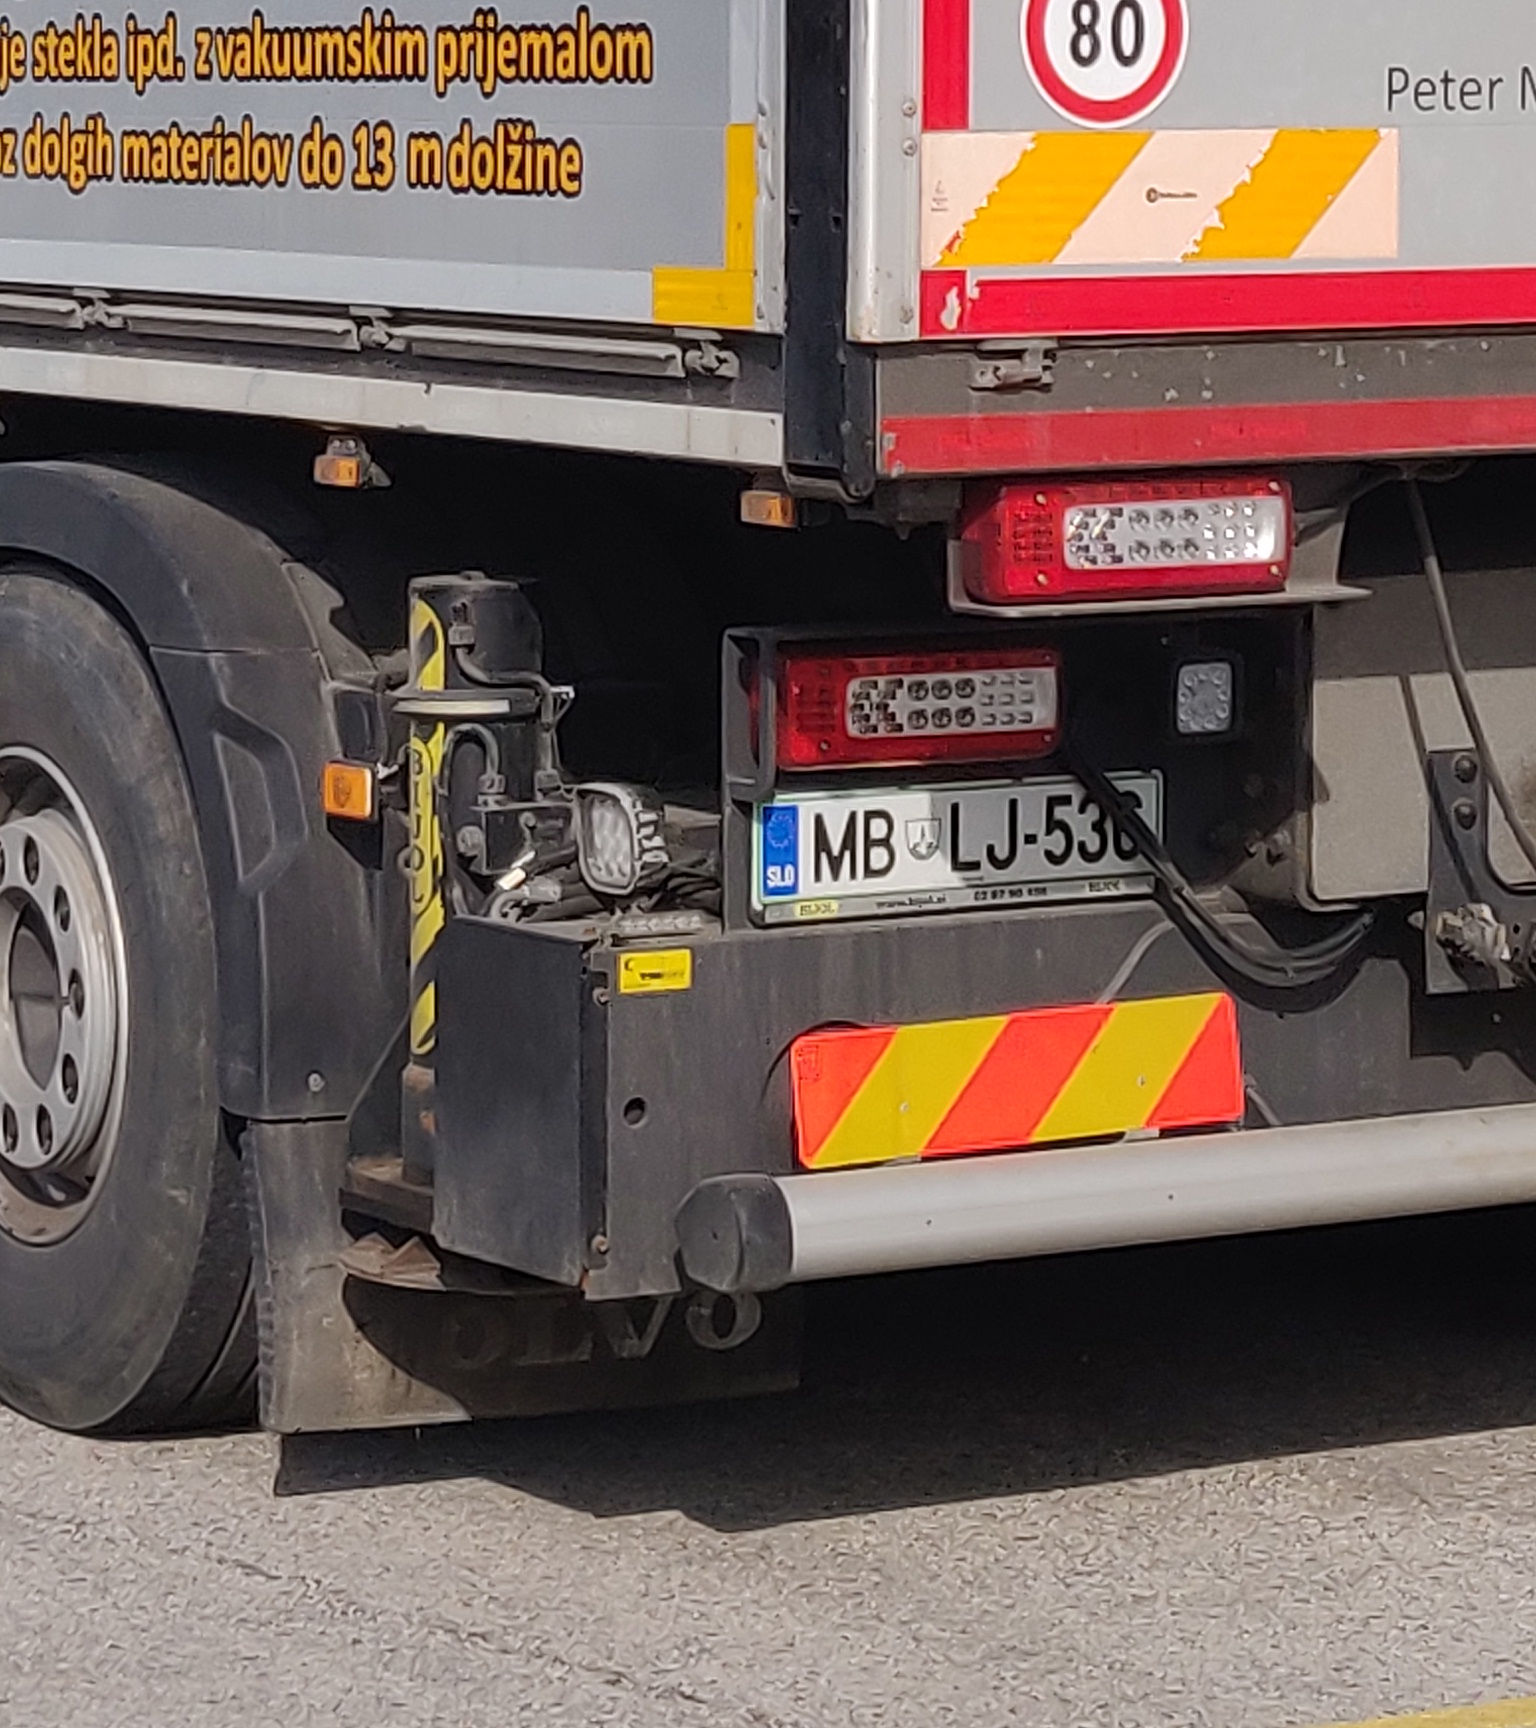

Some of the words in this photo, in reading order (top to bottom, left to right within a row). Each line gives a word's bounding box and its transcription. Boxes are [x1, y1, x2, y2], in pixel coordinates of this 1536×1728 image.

[32, 18, 119, 82] stekla
[125, 11, 186, 93] ipd.
[195, 25, 214, 78] z
[216, 7, 428, 80] vakuumskim
[435, 5, 654, 95] prijemalom
[1386, 66, 1503, 112] Peter
[23, 113, 113, 193] dolgih
[121, 119, 293, 186] materialov
[299, 117, 344, 183] do
[351, 124, 396, 190] 13
[406, 134, 444, 186] m
[447, 119, 584, 198] dolžine
[766, 864, 794, 888] SLO
[813, 808, 896, 884] MB
